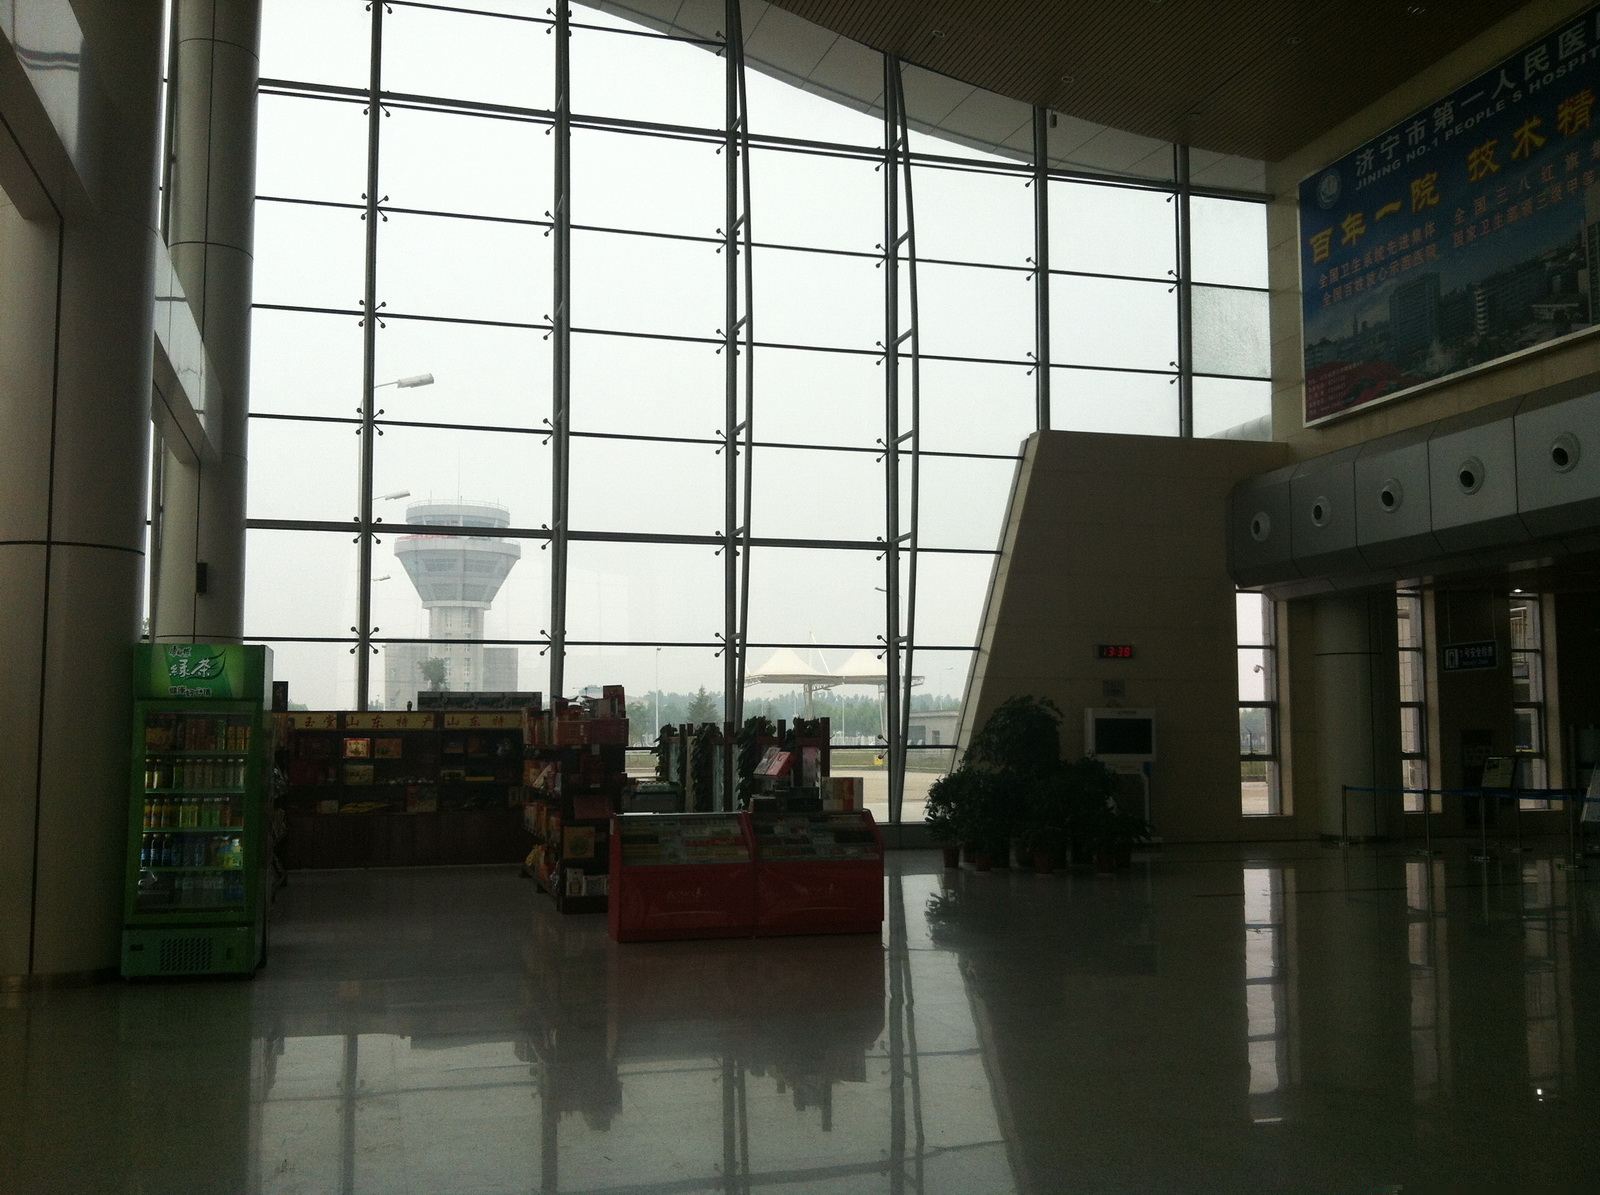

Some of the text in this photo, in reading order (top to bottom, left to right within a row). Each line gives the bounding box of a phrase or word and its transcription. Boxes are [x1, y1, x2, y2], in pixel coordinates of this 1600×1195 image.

[1356, 159, 1401, 191] JINING
[1406, 137, 1440, 163] NO.1
[1309, 171, 1440, 264] 百年一院
